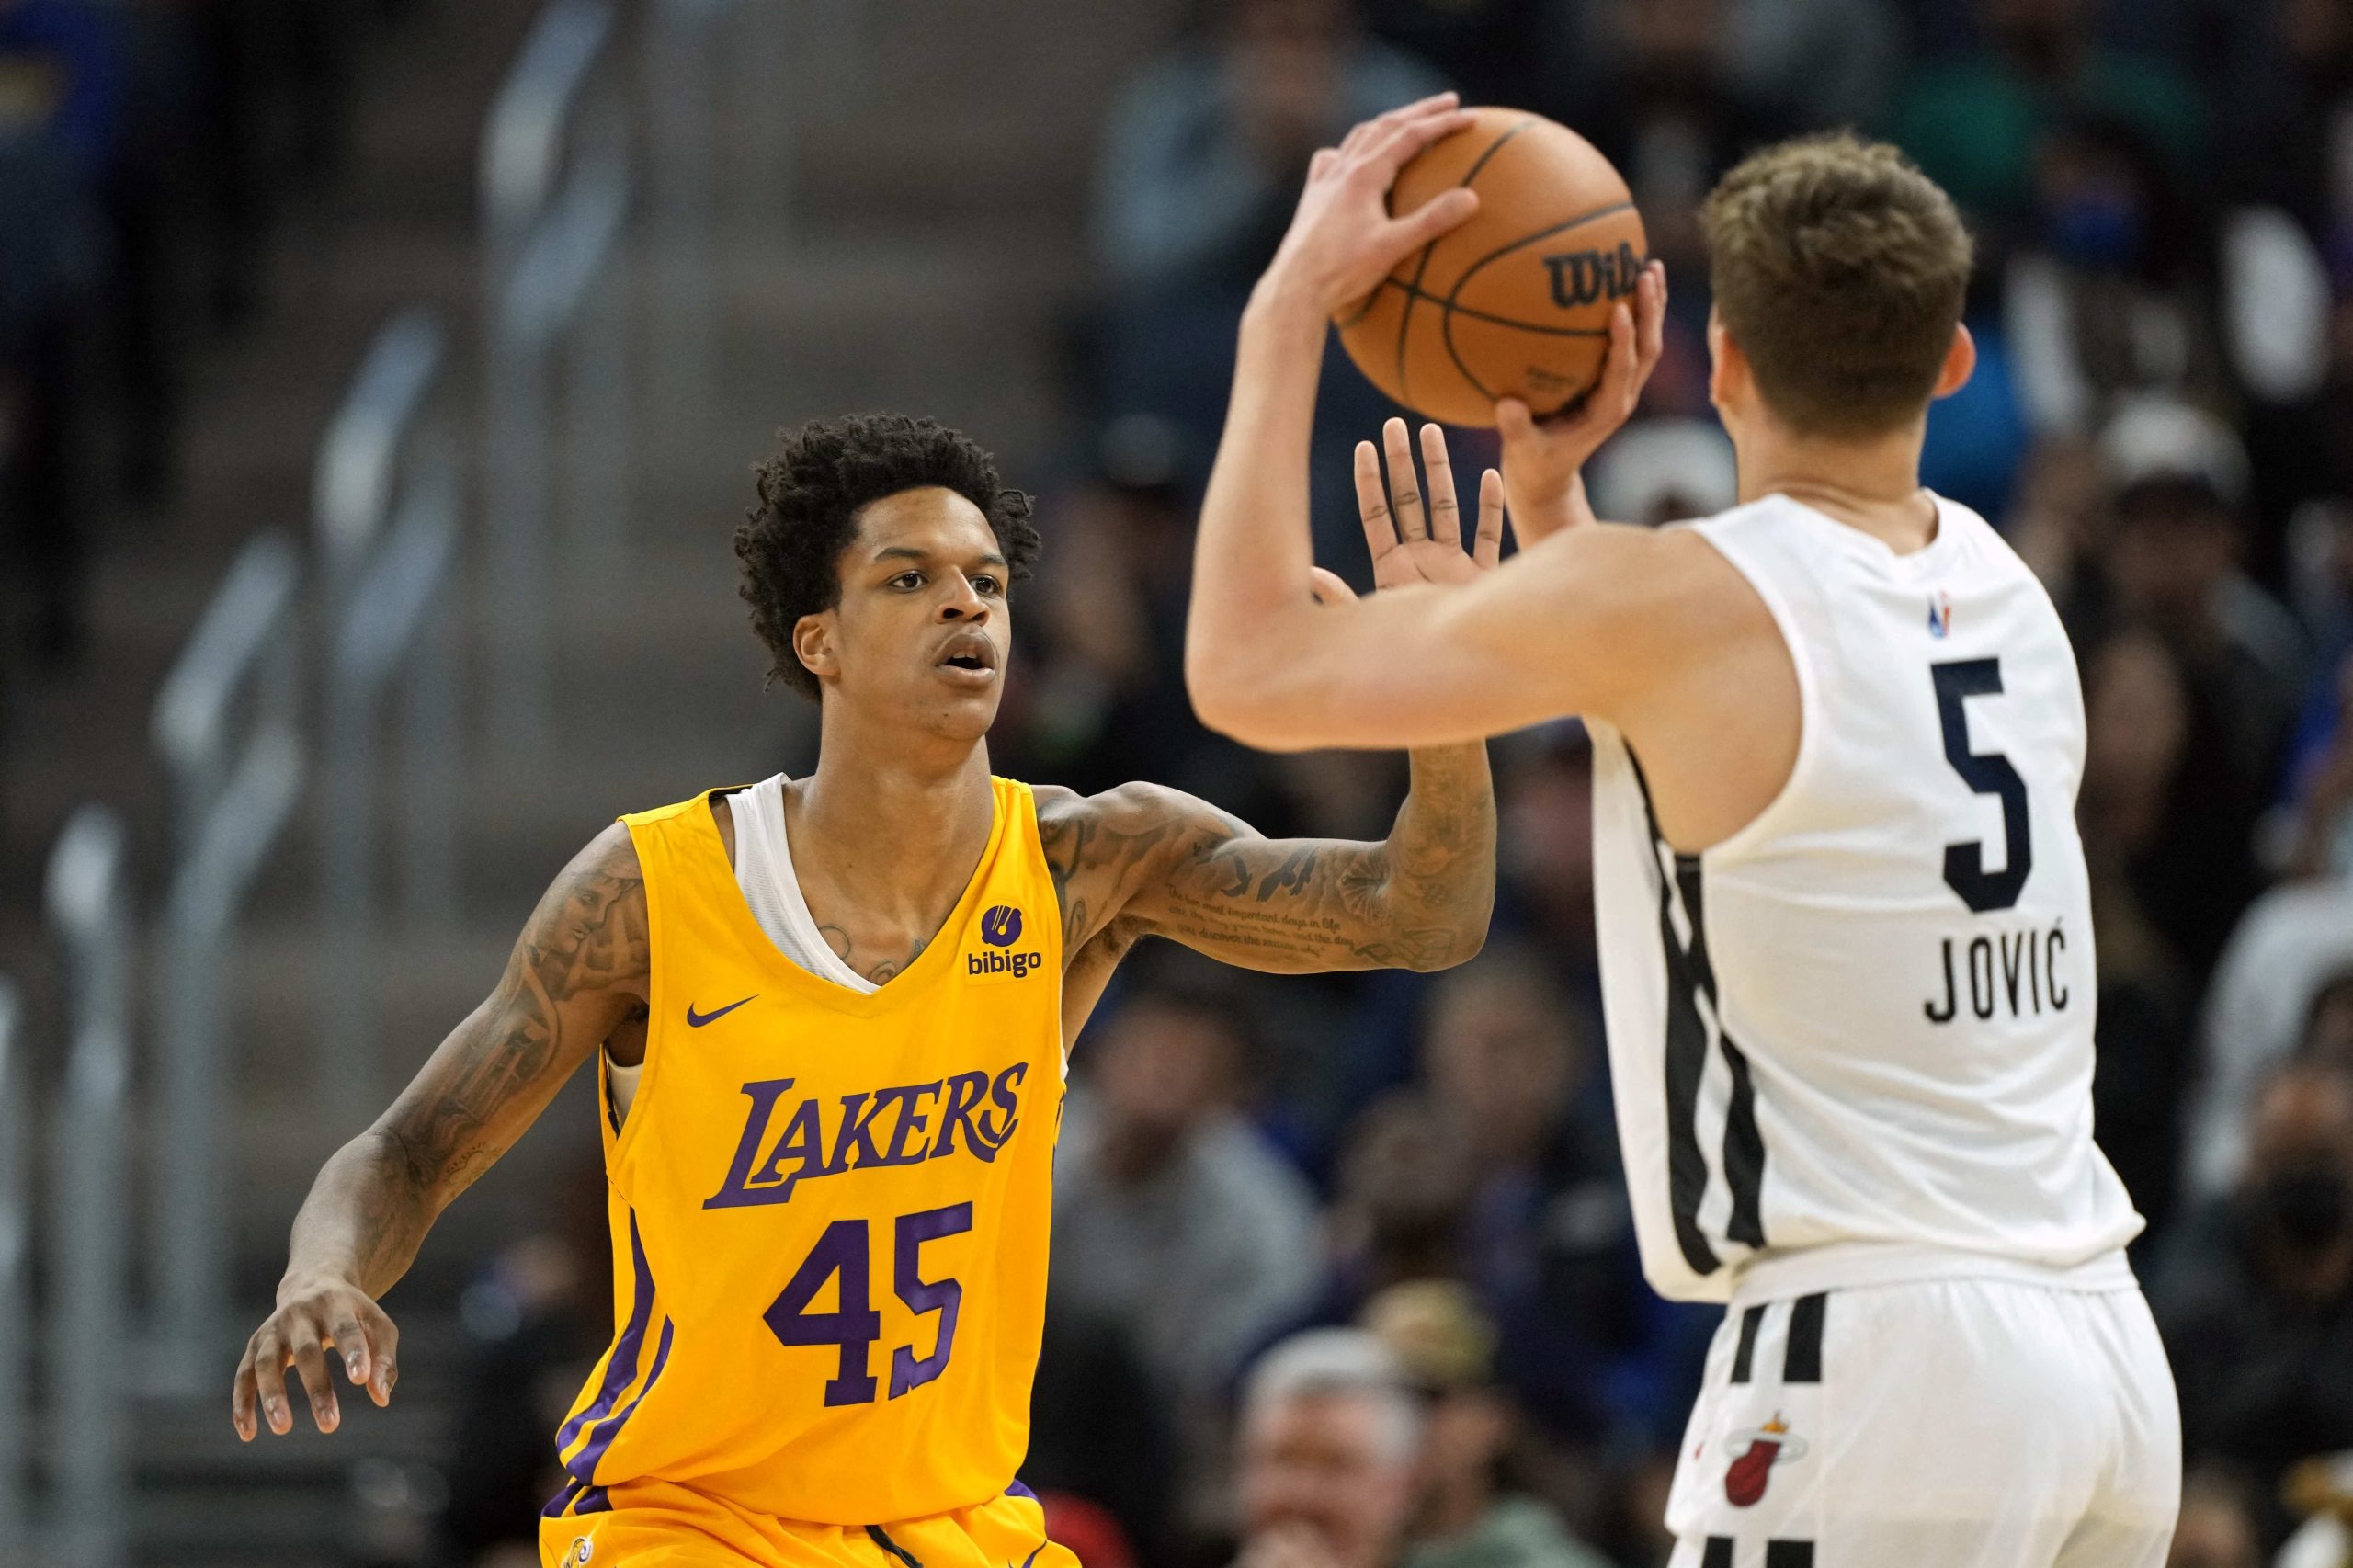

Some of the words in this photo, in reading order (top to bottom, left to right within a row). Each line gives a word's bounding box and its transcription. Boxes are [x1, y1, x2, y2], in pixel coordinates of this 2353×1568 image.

[1930, 657, 2032, 913] 5
[1199, 926, 1240, 943] discover
[1228, 905, 1279, 924] important
[1281, 914, 1307, 931] days
[1309, 919, 1321, 929] in
[1322, 917, 1341, 934] life
[1334, 936, 1355, 951] day
[968, 949, 1041, 978] bibigo
[1924, 917, 2068, 1024] JOVIĆ
[702, 1062, 1029, 1210] LAKERS
[762, 1200, 973, 1407] 45
